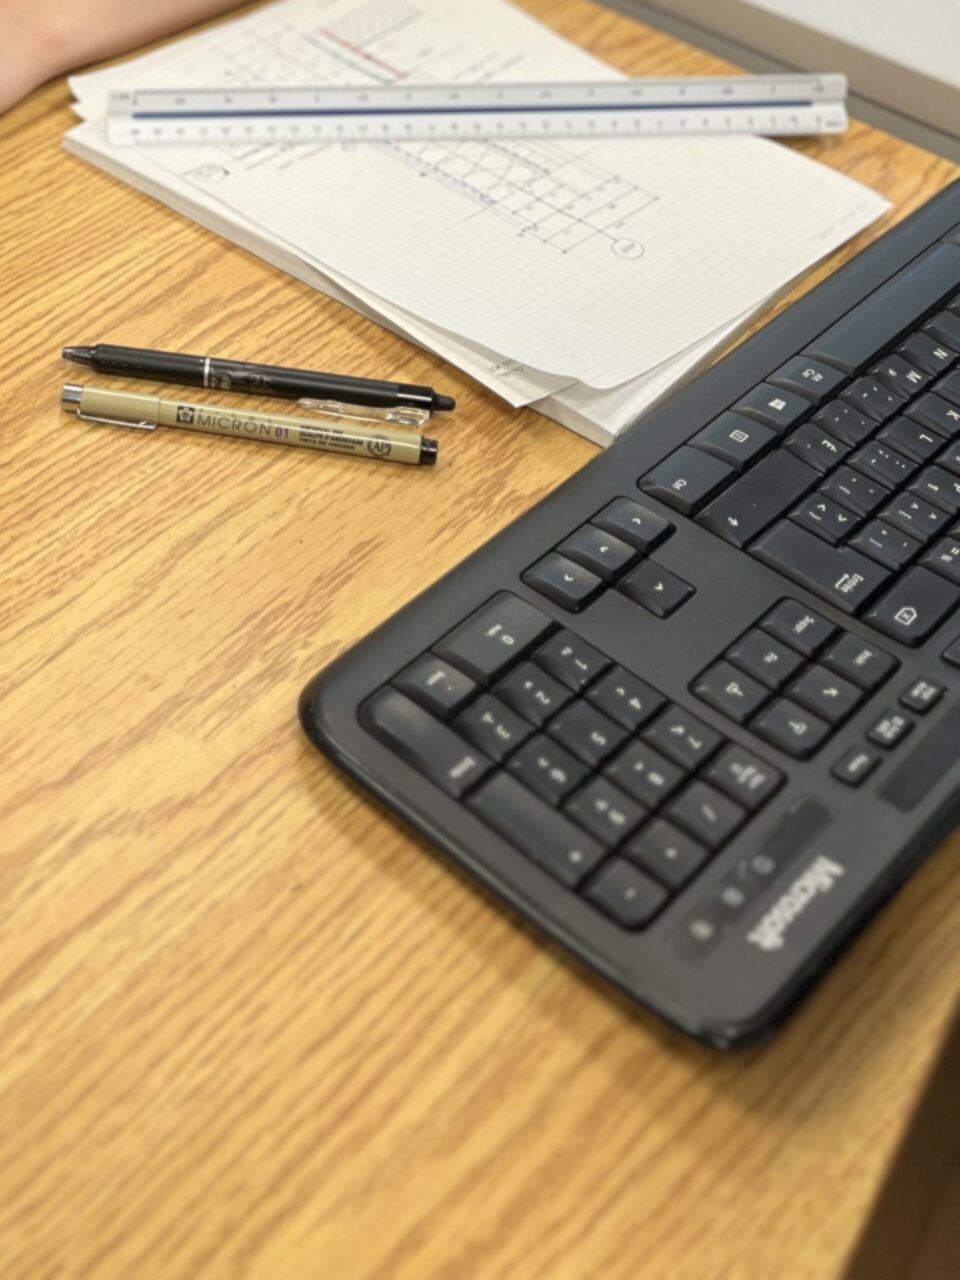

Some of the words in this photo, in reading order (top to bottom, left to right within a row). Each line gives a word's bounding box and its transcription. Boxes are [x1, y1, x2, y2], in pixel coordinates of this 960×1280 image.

[196, 413, 271, 437] MICRON
[275, 426, 290, 439] 01
[745, 854, 846, 951] Microsoft
